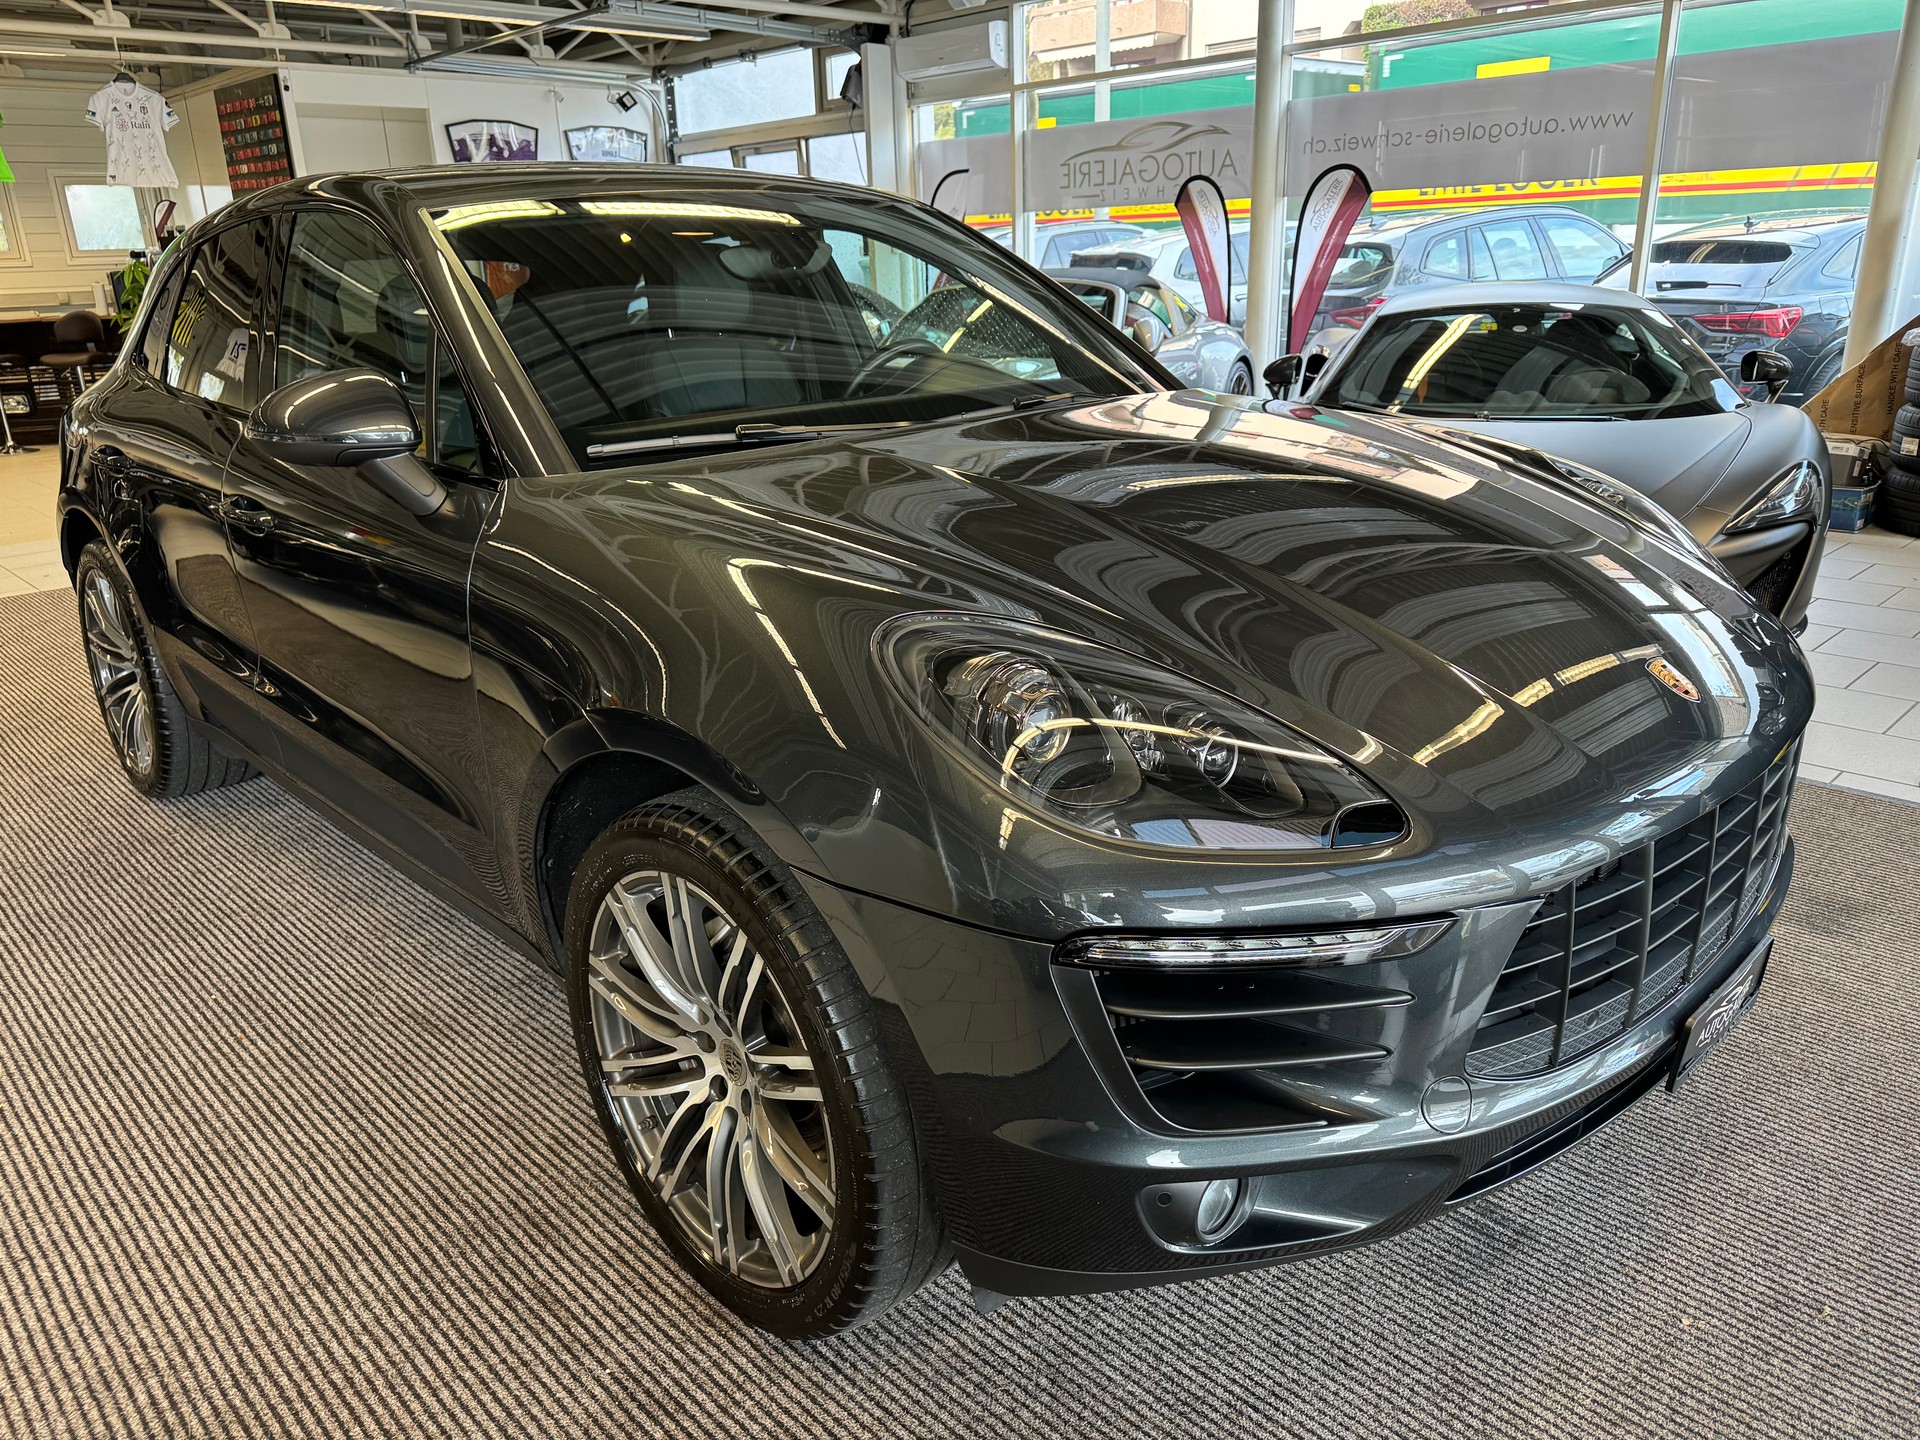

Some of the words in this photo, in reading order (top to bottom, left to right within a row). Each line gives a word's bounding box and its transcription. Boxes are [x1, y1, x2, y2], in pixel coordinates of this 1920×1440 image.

[130, 121, 151, 130] Rain
[1312, 178, 1344, 233] AUTOGALERIE
[1893, 343, 1903, 362] CARE
[1890, 363, 1899, 384] WITH
[1850, 401, 1861, 435] ENSITIVE
[1856, 364, 1866, 398] SURFACE
[1887, 385, 1897, 415] HANDLE
